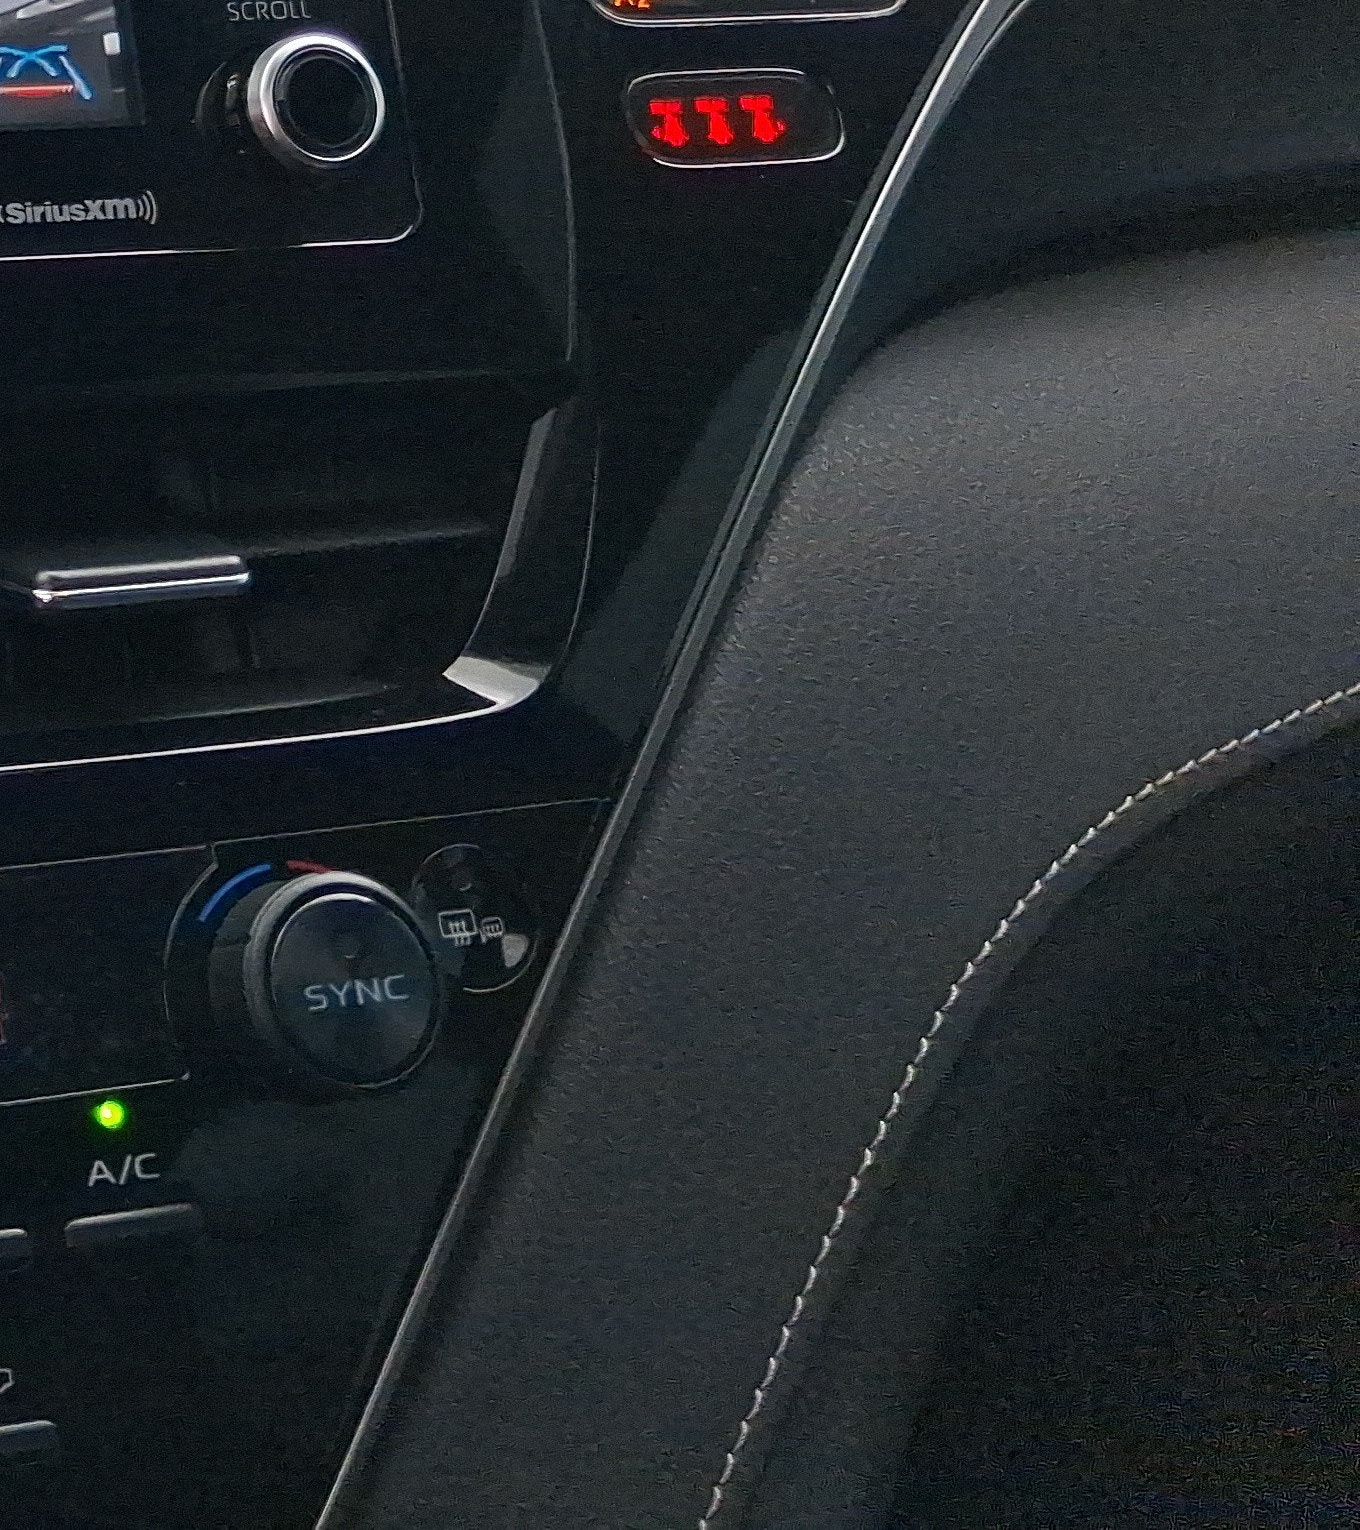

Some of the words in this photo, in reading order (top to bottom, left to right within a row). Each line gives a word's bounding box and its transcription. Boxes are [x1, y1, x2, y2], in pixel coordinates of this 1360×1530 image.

[226, 1, 312, 22] SCROLL
[303, 973, 410, 1012] SYNC
[87, 1152, 162, 1188] A/C
